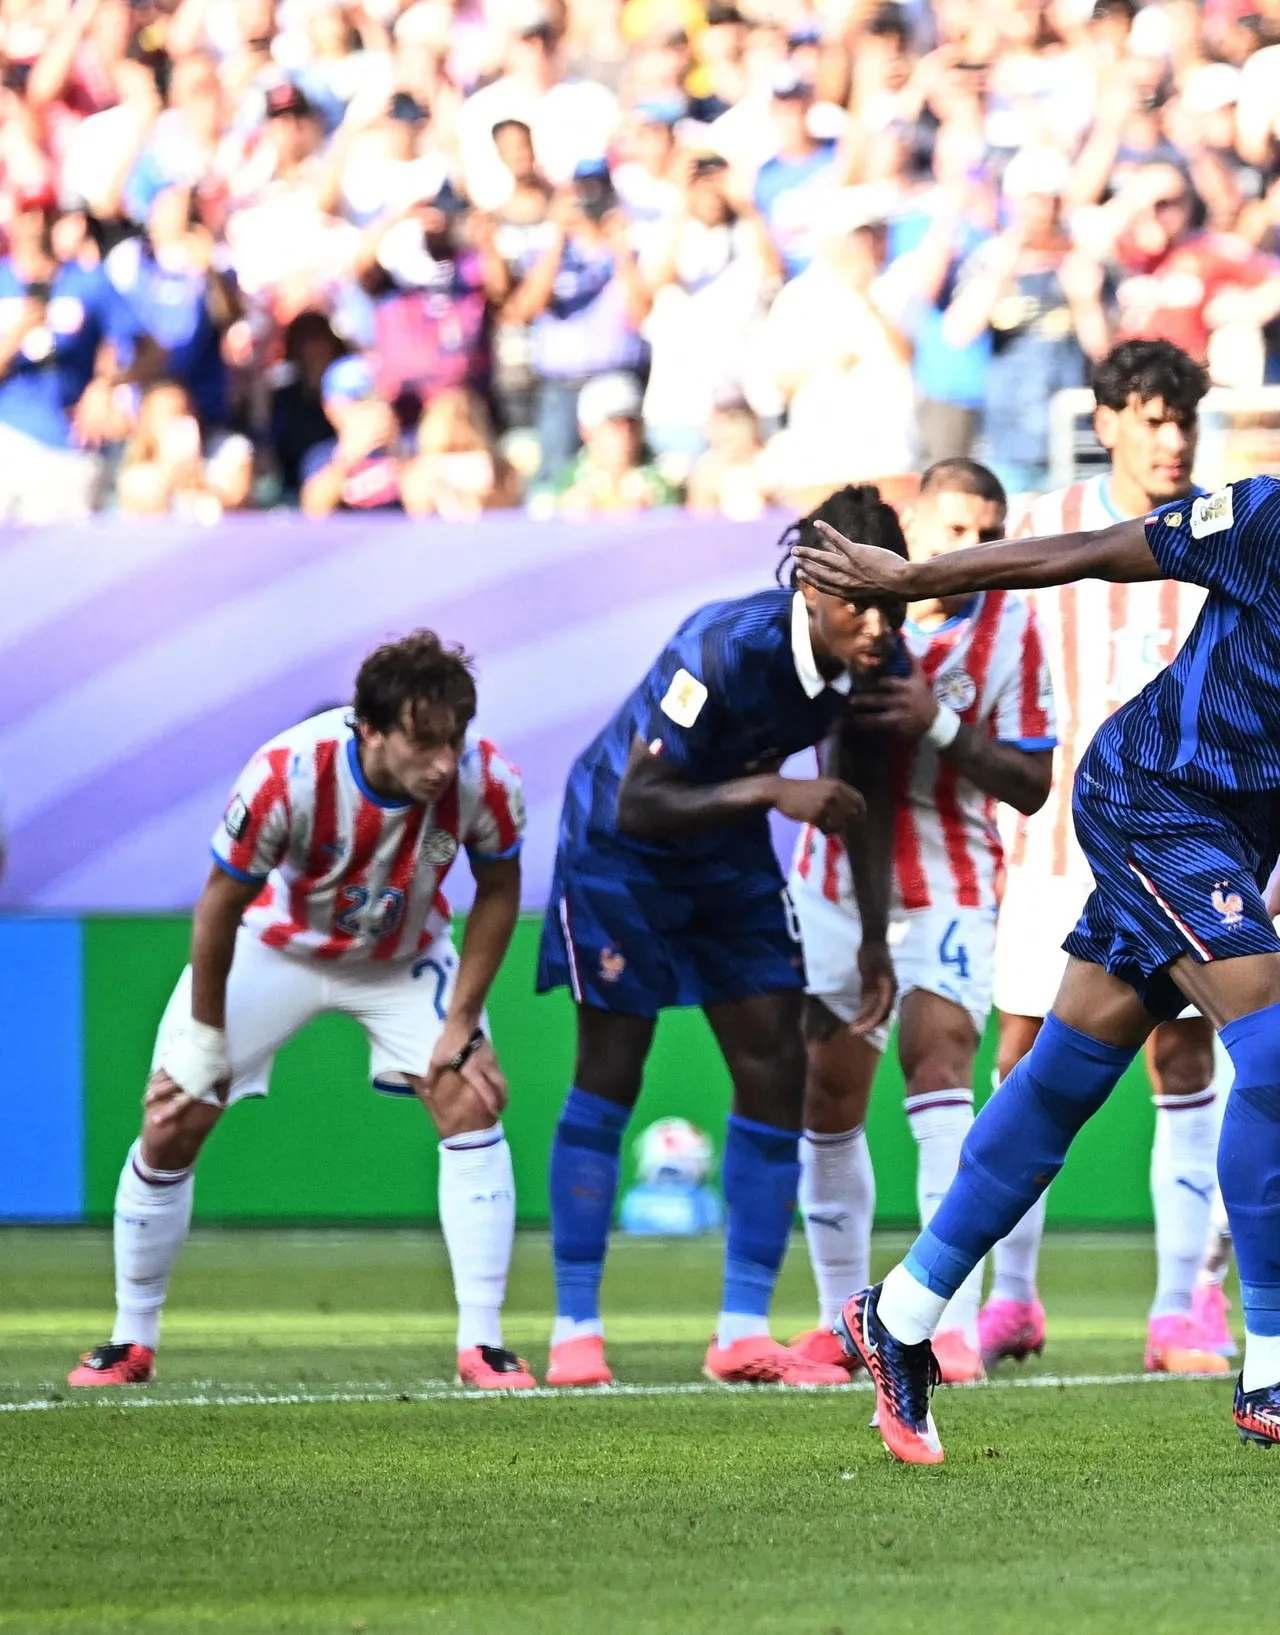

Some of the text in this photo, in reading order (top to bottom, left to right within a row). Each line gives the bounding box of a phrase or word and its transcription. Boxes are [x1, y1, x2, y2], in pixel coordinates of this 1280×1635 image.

[337, 885, 403, 938] 23
[939, 919, 969, 978] 4
[411, 955, 454, 1020] 2
